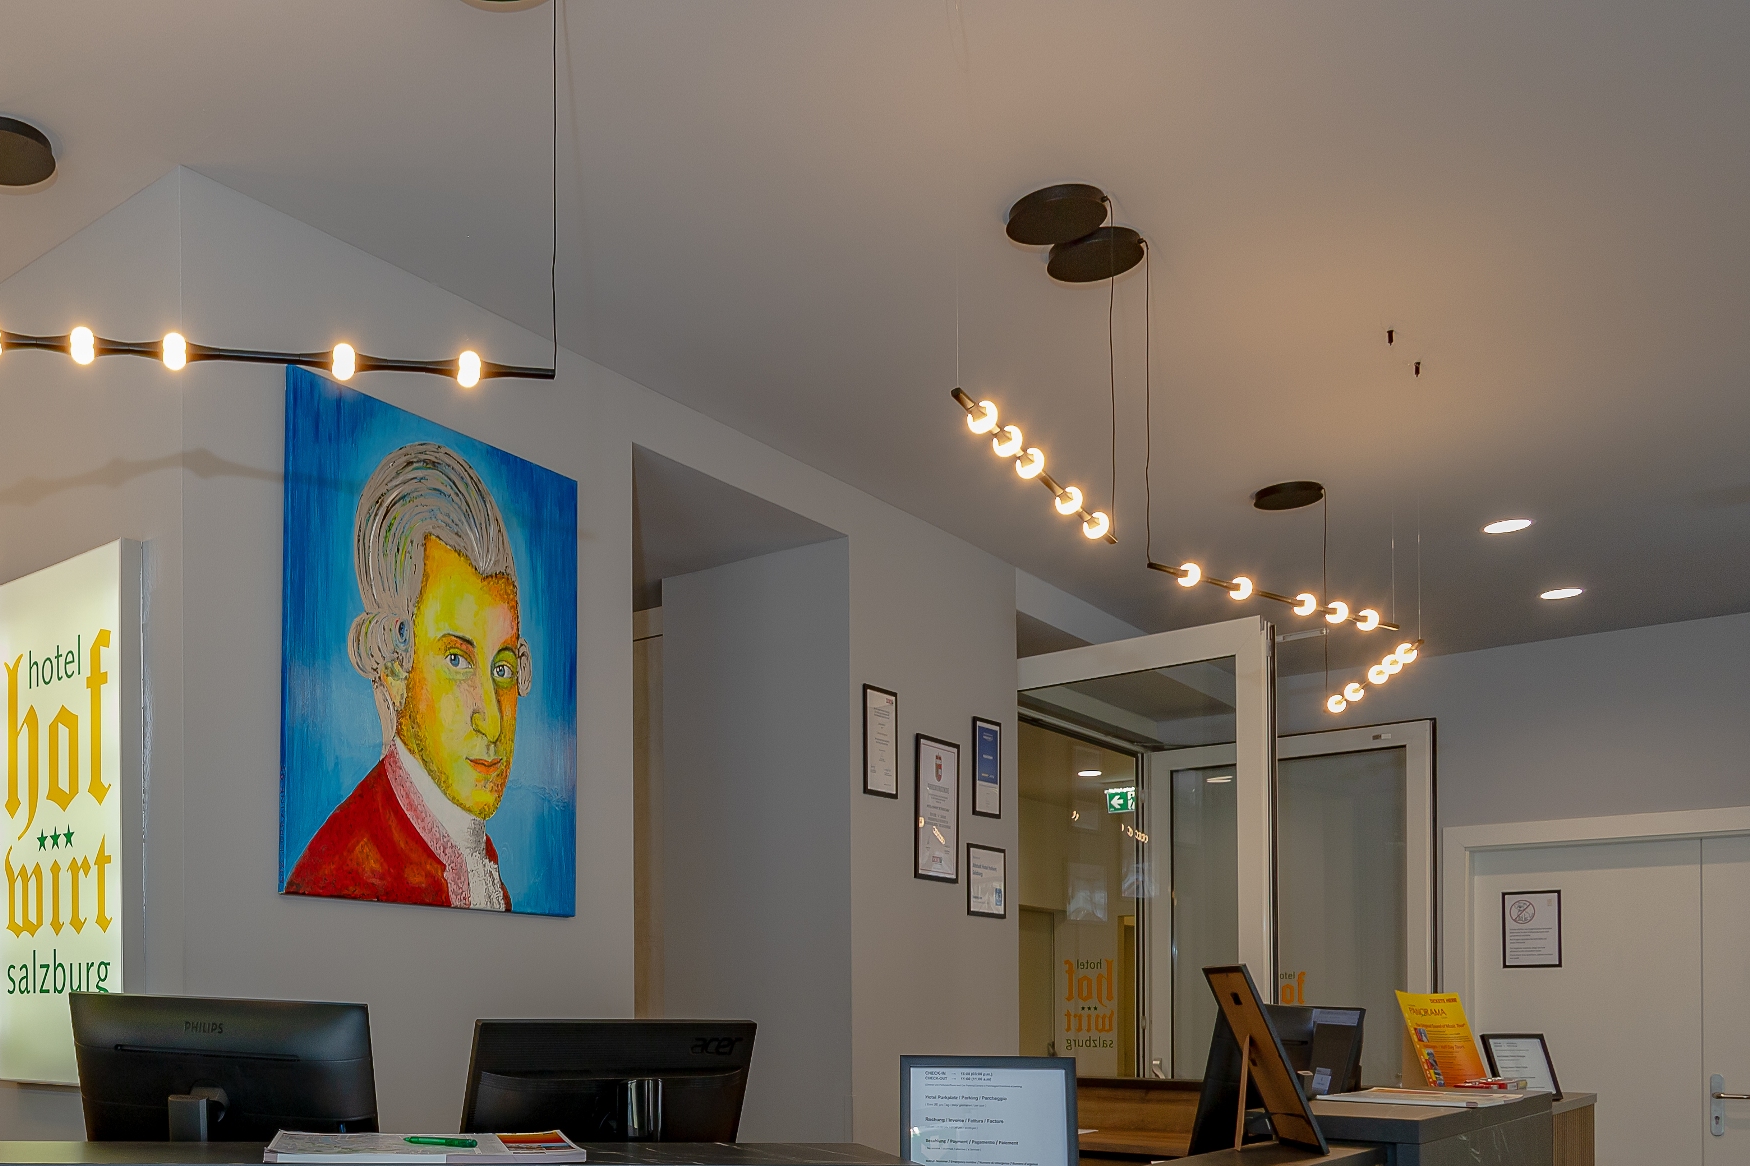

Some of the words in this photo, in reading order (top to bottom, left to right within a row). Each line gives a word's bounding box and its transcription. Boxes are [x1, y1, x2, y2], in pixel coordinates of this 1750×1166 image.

[28, 634, 82, 690] hotel
[4, 628, 112, 841] hof
[4, 833, 113, 938] wirt
[6, 949, 111, 994] salzburg
[1280, 971, 1295, 980] otel
[1281, 971, 1306, 1005] of
[184, 1021, 223, 1034] PHILIPS
[1408, 1007, 1447, 1016] PANORAMA
[690, 1037, 743, 1056] acer
